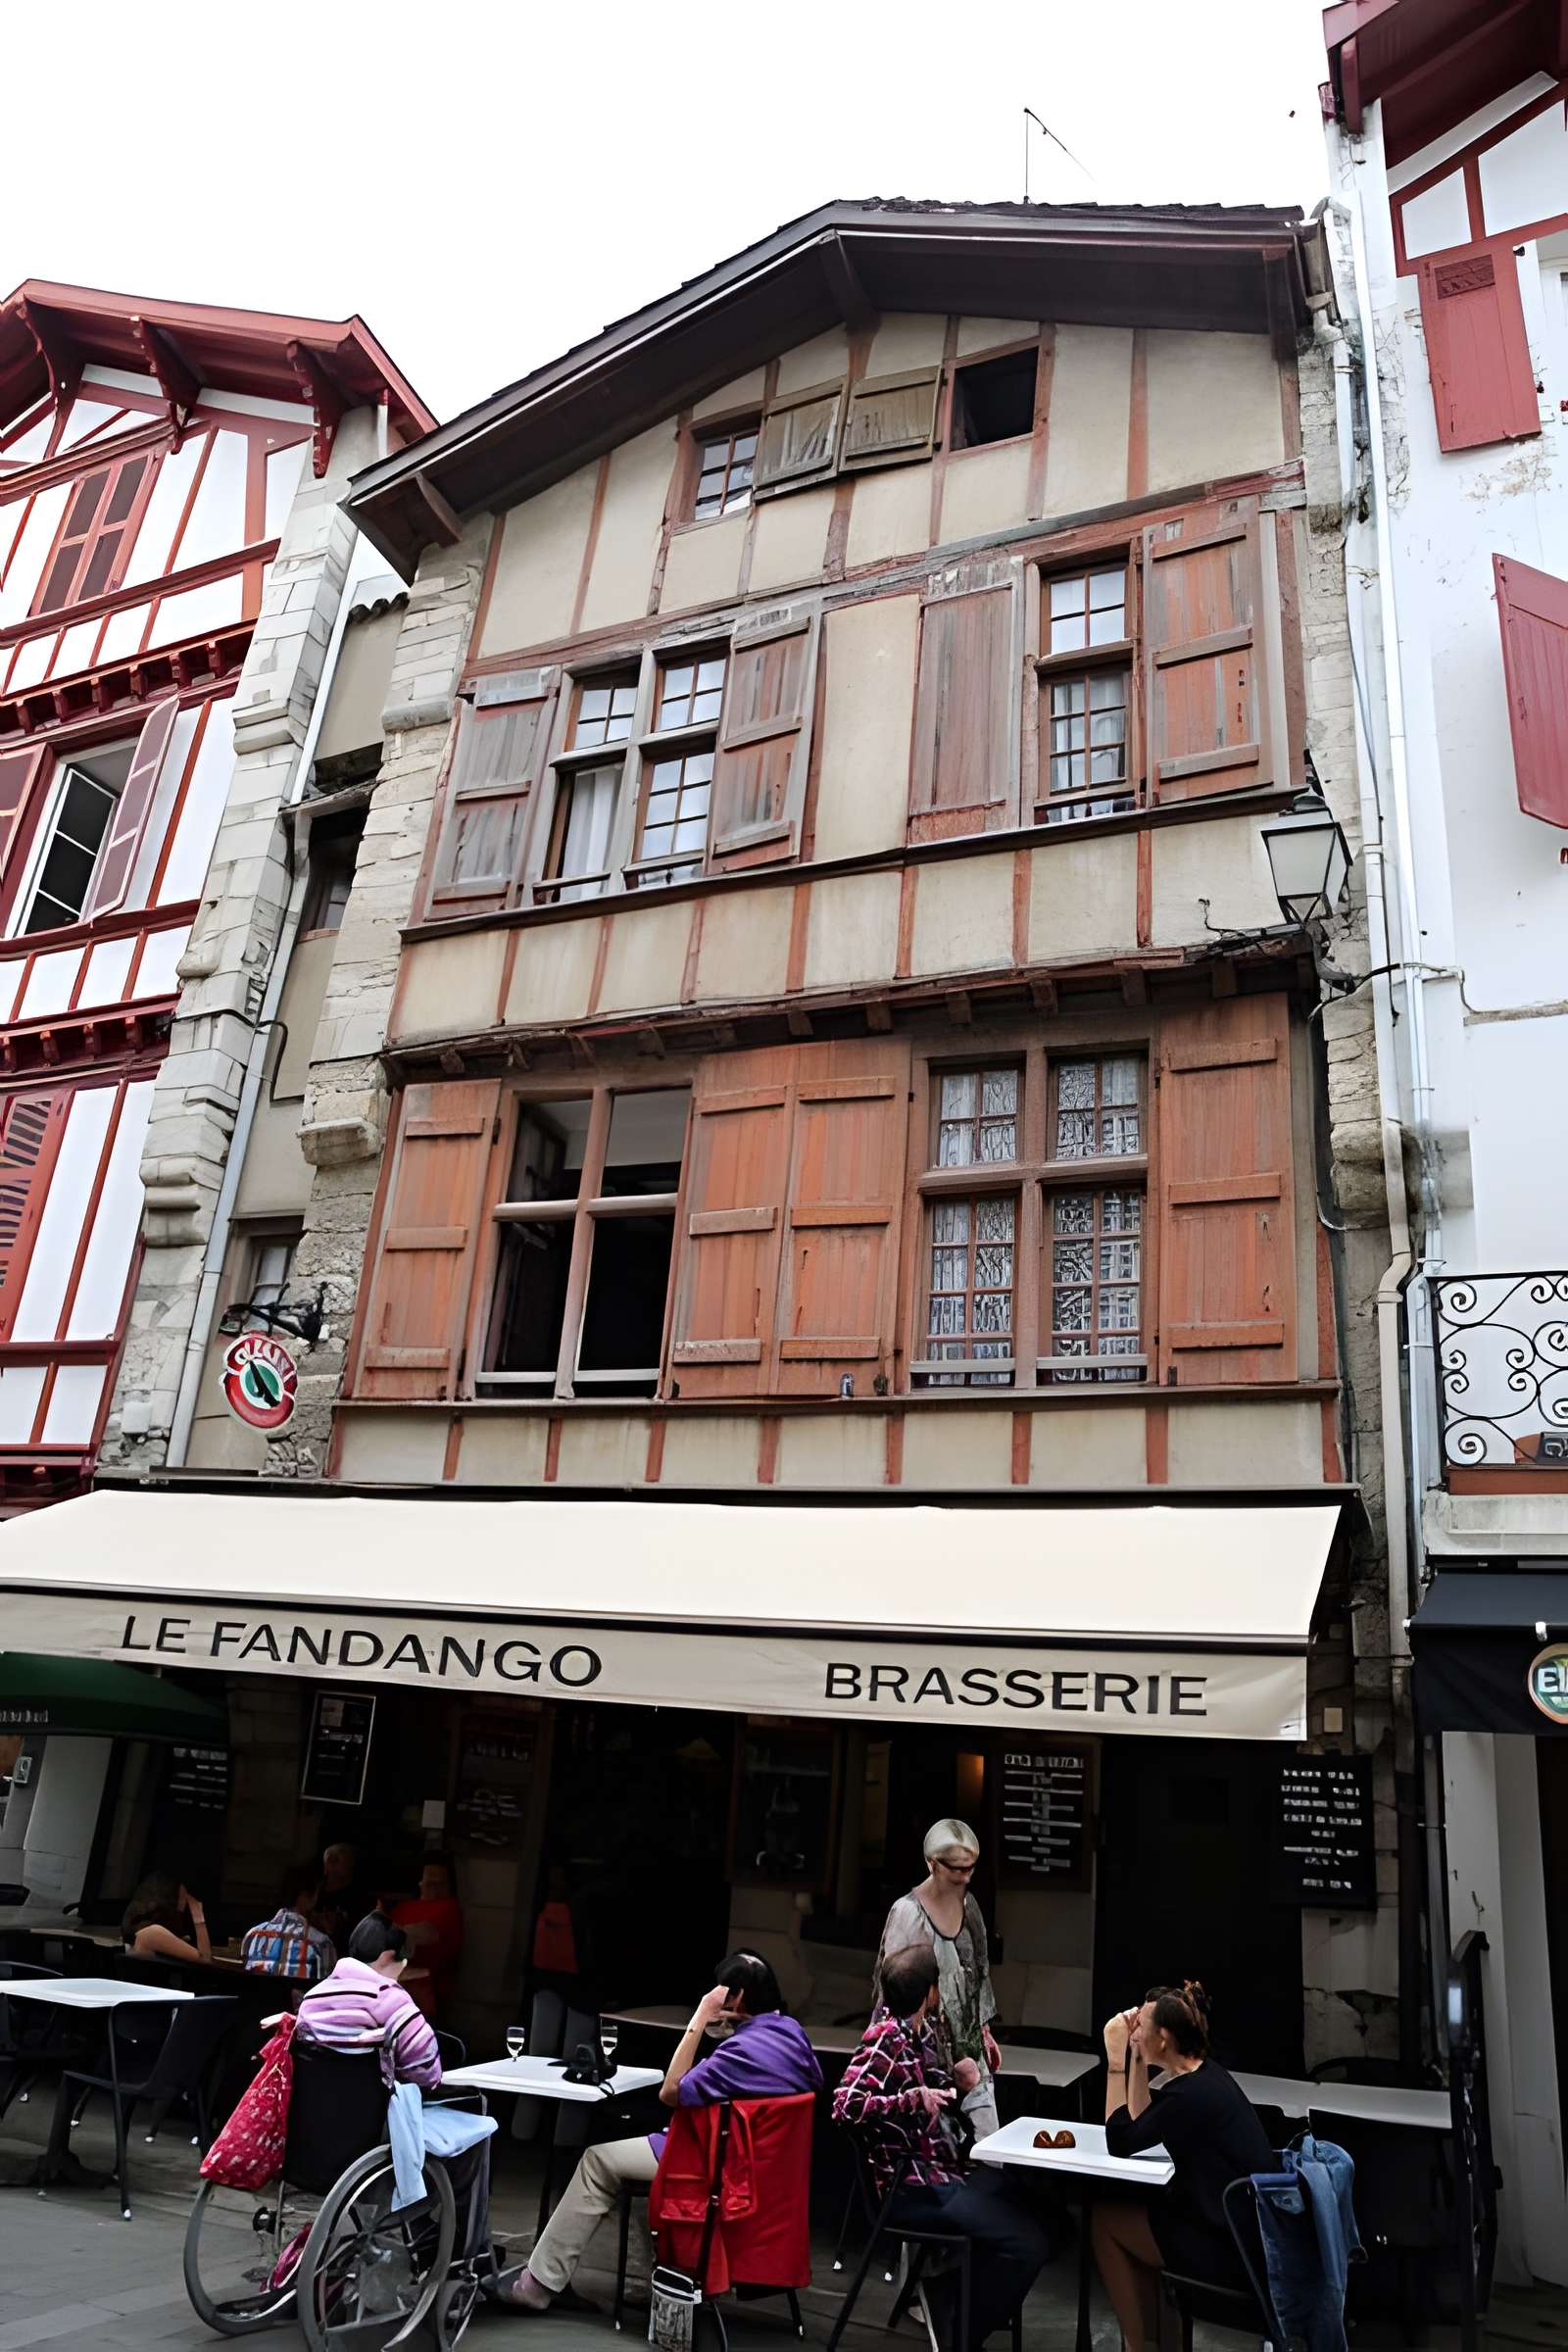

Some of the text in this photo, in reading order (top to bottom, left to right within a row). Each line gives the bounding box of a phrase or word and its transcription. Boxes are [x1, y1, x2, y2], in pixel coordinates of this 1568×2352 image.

[122, 1615, 603, 1687] LE FANDANGO
[824, 1663, 1207, 1716] BRASSERIE
